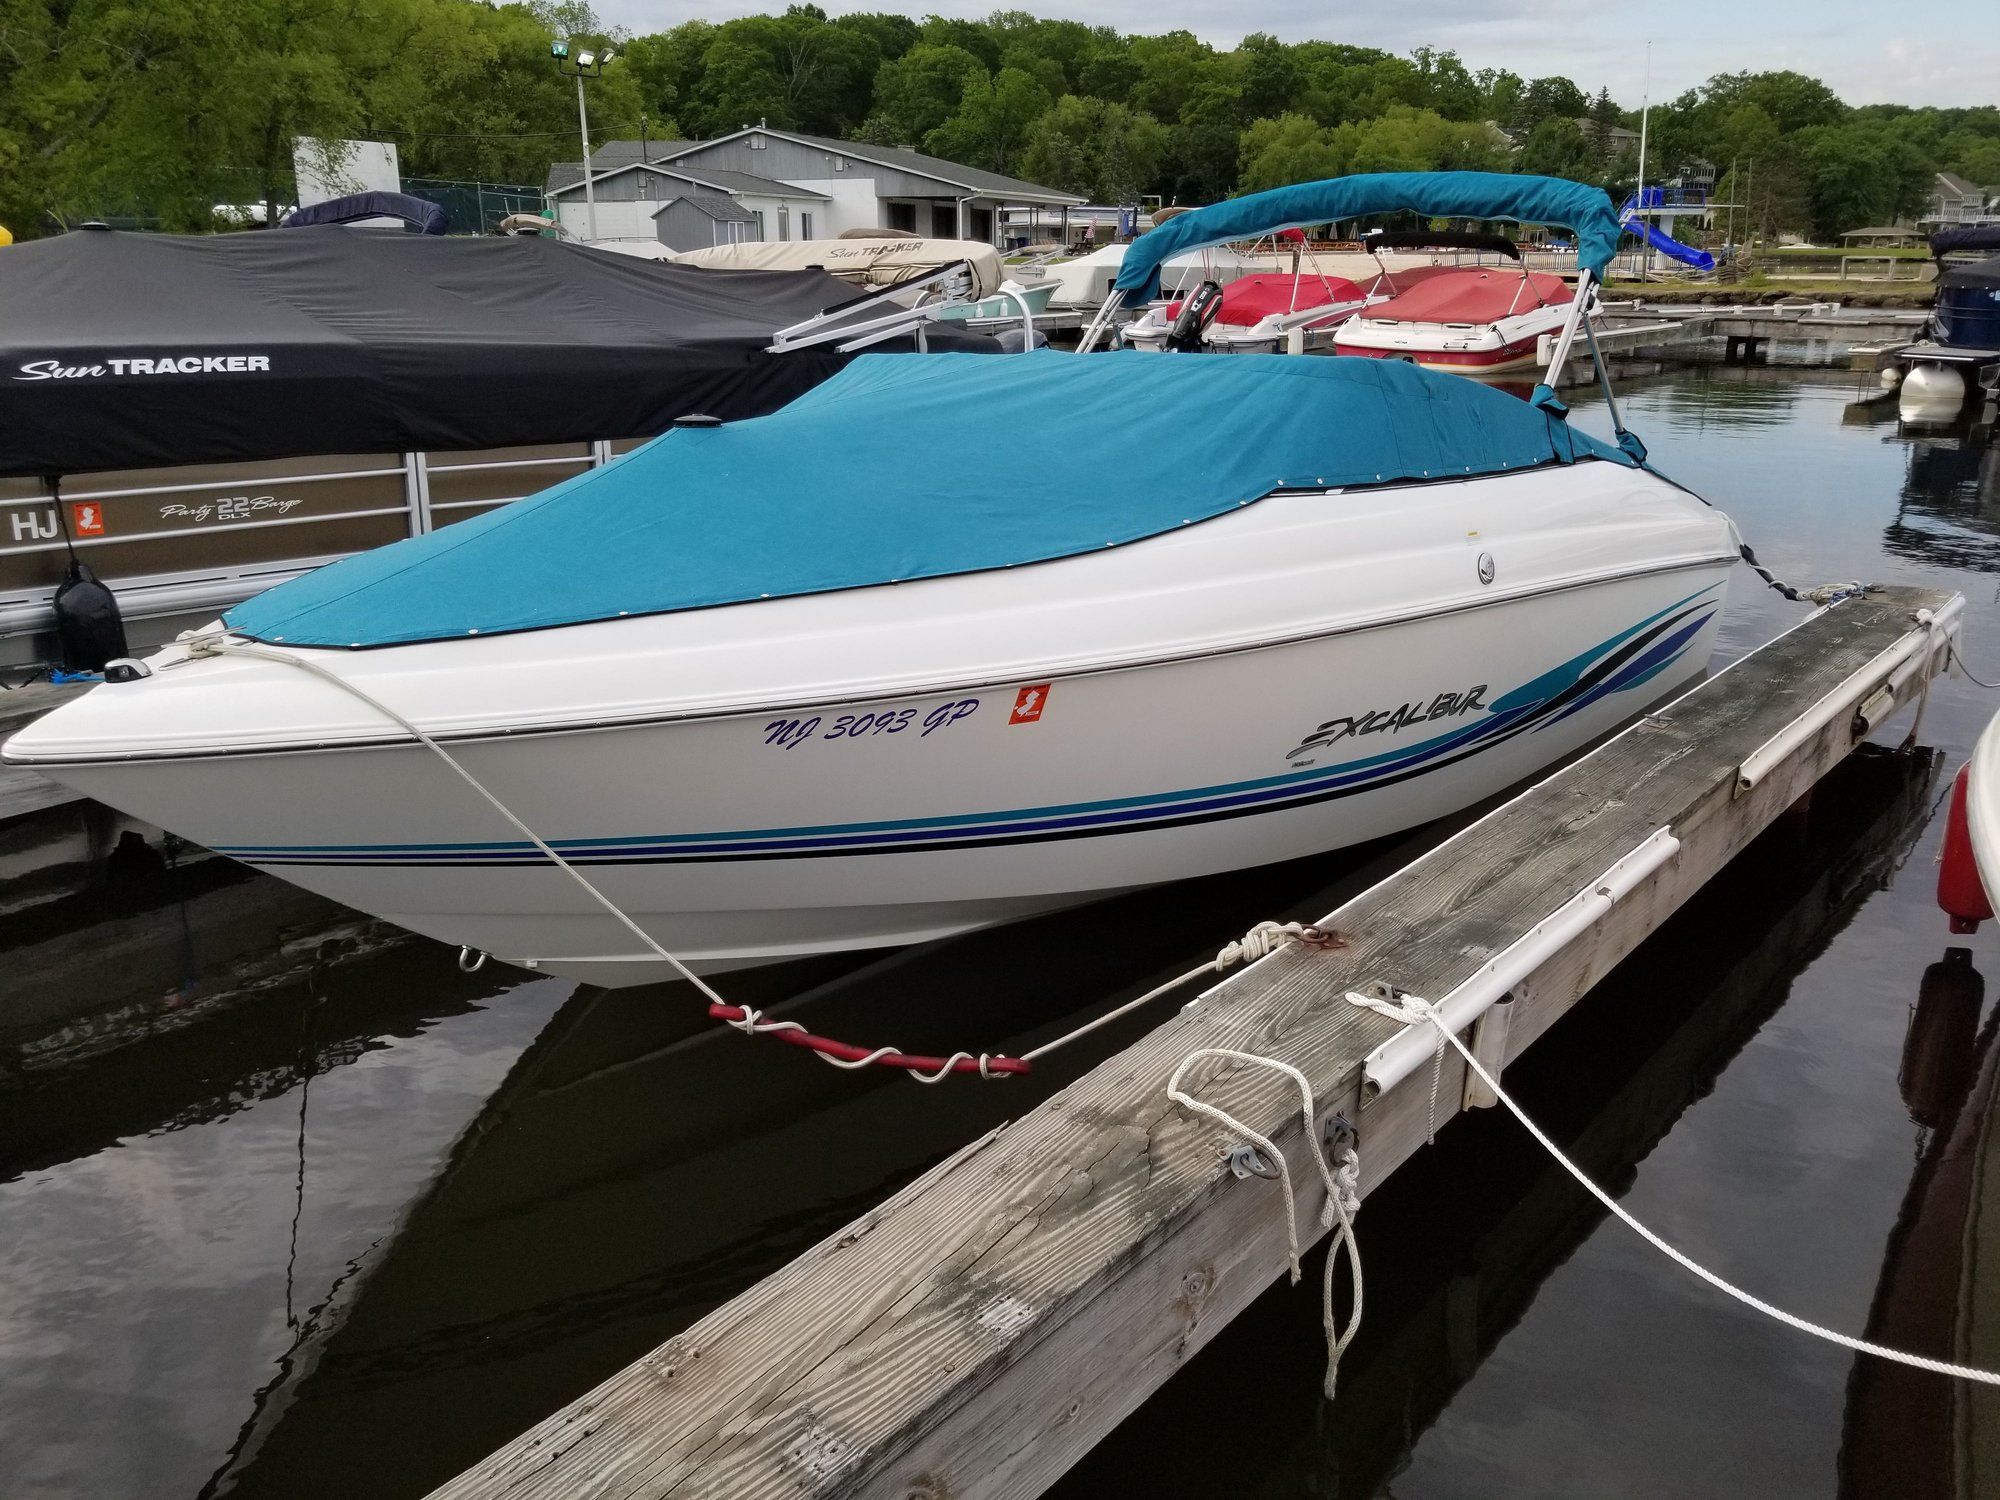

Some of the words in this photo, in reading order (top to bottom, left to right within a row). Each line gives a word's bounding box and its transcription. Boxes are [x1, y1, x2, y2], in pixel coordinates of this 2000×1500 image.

[825, 247, 860, 259] Sun
[11, 360, 107, 381] Sun
[107, 356, 270, 376] TRACKER
[160, 504, 216, 522] Party
[216, 496, 251, 515] 22
[250, 496, 304, 514] Barge
[218, 512, 251, 521] DLX
[11, 510, 58, 541] HJ
[764, 716, 822, 751] NJ
[823, 708, 918, 740] 3093
[920, 699, 980, 738] GP
[1285, 684, 1488, 760] EXCALIBUR
